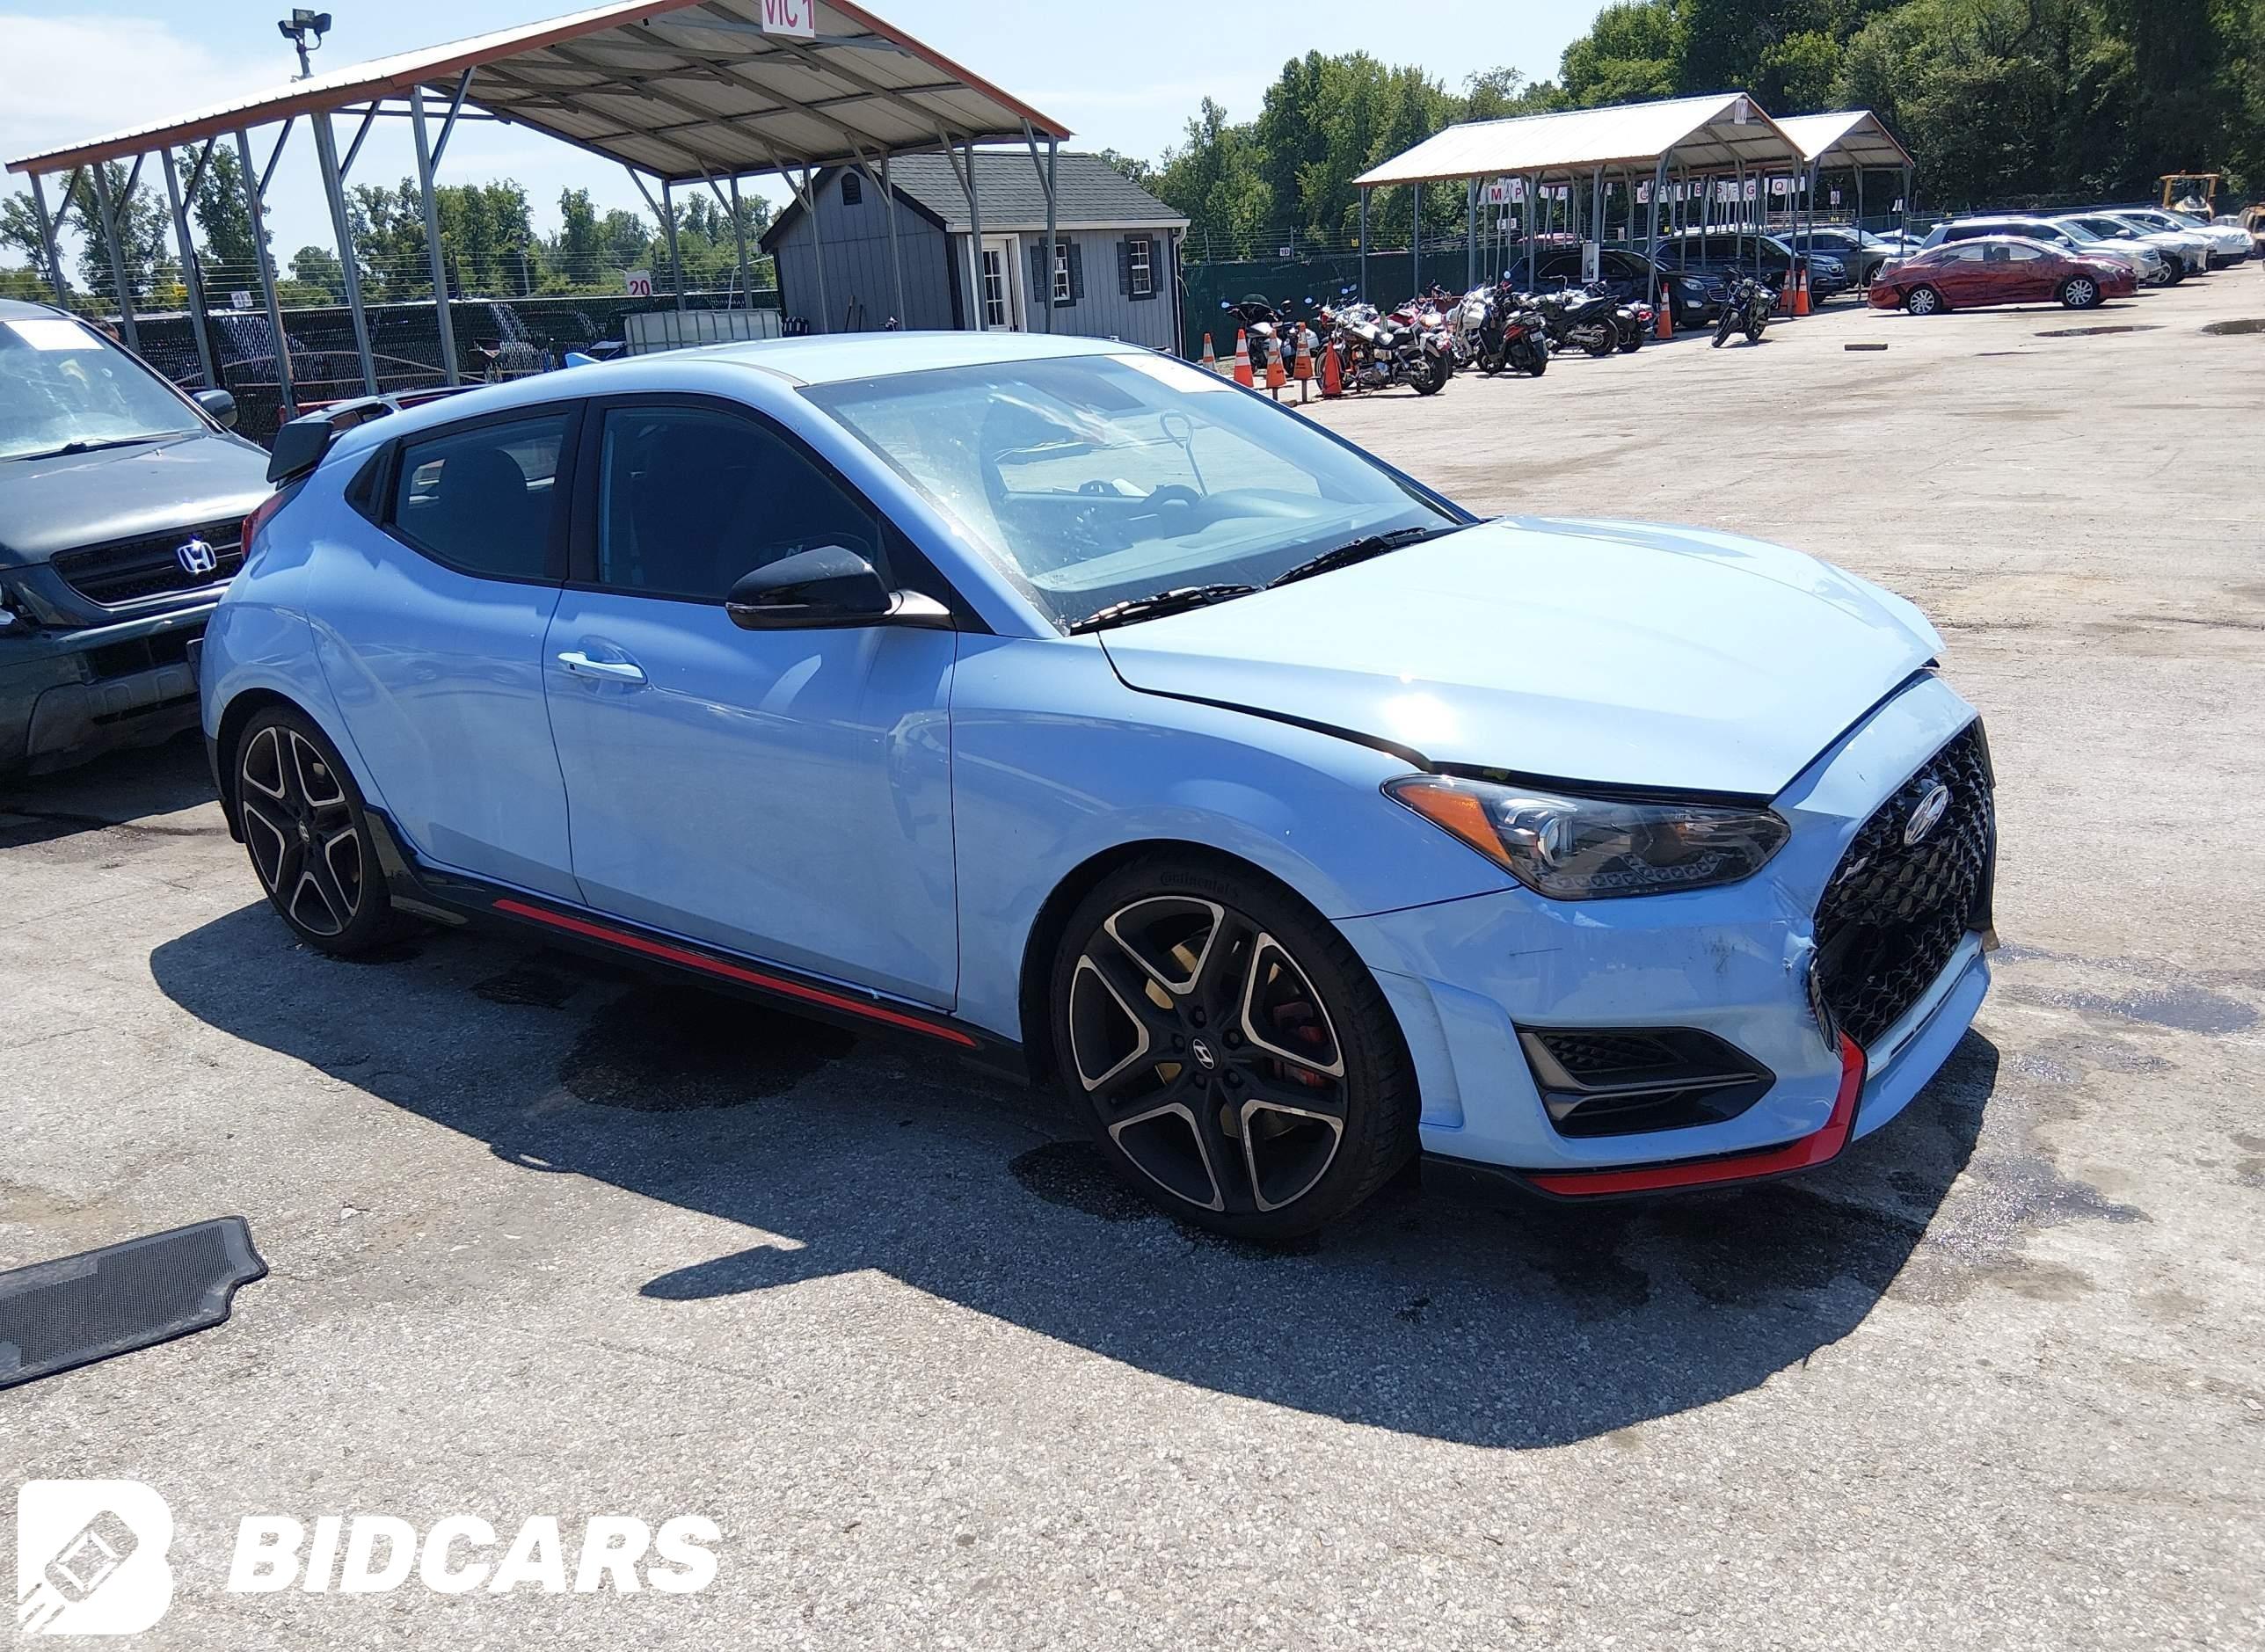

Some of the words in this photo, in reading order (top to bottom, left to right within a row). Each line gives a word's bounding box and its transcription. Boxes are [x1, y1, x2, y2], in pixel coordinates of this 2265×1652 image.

[765, 0, 797, 27] VIC
[802, 0, 813, 29] 1
[1746, 185, 1755, 194] G
[1774, 181, 1784, 192] Q
[1490, 187, 1502, 201] M
[1515, 187, 1522, 200] P
[630, 280, 651, 295] 20
